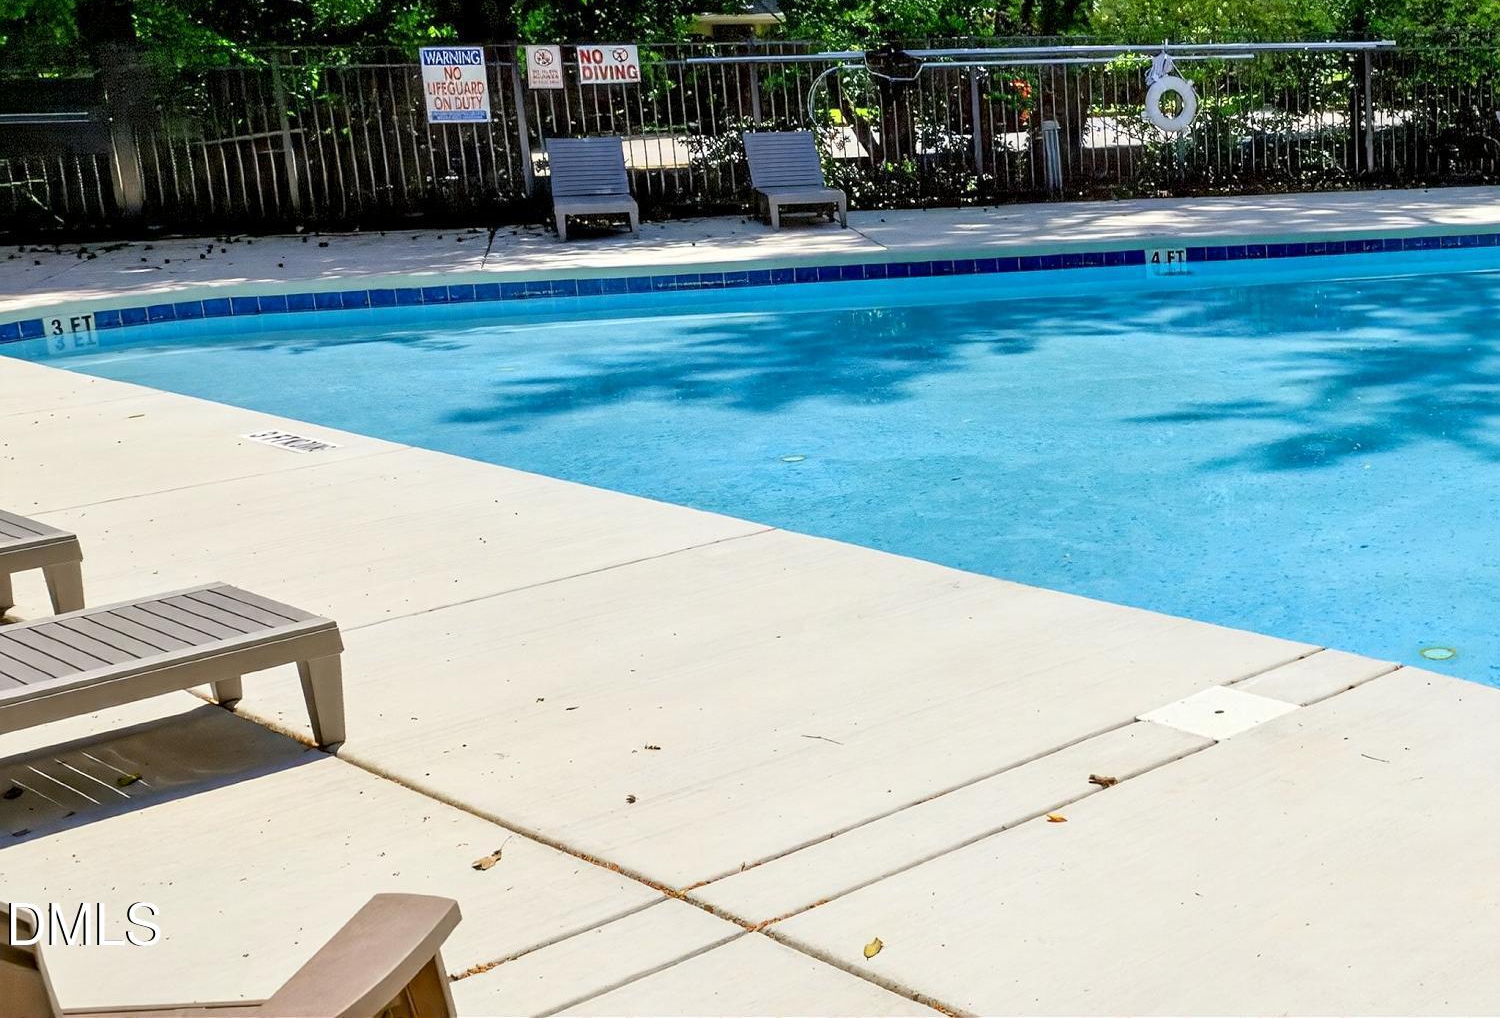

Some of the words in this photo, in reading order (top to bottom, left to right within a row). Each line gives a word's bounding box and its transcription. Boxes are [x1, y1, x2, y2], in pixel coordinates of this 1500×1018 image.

[424, 50, 480, 65] WARNING
[580, 49, 603, 64] NO
[444, 66, 462, 81] NO
[582, 65, 638, 80] DIVING
[427, 81, 485, 96] LIFEGUARD
[434, 96, 452, 111] ON
[455, 96, 483, 110] DUTY
[1151, 250, 1160, 264] 4
[1167, 250, 1184, 263] FT
[51, 319, 64, 335] 3
[70, 314, 92, 333] FT
